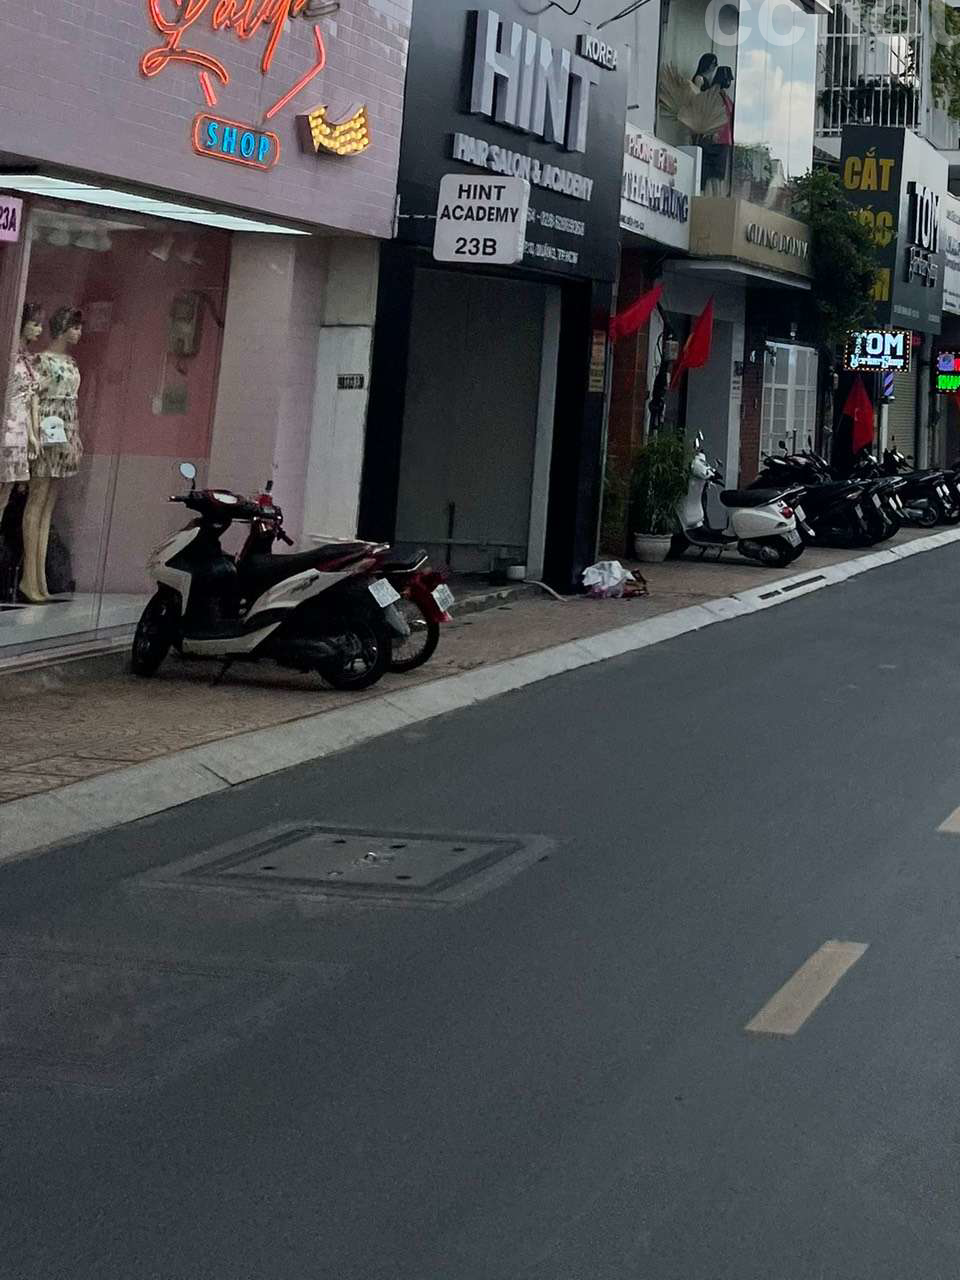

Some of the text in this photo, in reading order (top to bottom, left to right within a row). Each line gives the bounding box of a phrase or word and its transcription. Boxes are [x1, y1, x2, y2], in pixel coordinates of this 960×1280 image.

[584, 34, 617, 70] KOREA
[470, 9, 598, 154] HINT
[206, 122, 270, 161] SHOP
[843, 146, 895, 192] CẮT
[458, 183, 507, 201] HINT
[439, 204, 520, 223] ACADEMY
[454, 236, 497, 257] 23B
